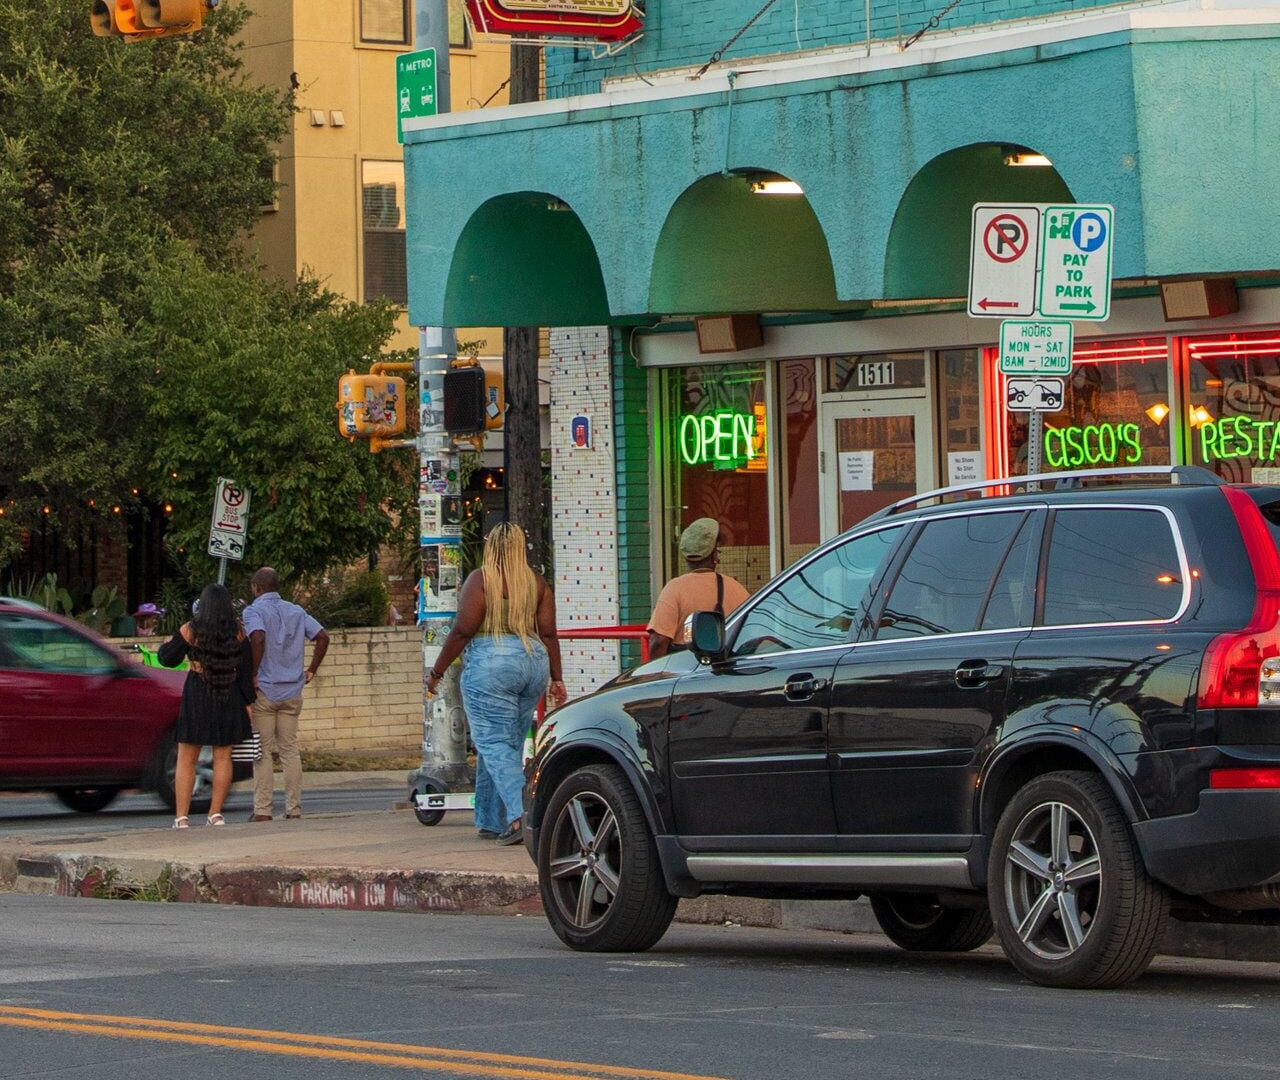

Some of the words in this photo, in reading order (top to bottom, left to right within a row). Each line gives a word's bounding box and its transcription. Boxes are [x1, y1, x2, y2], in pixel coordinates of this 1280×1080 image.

[405, 57, 432, 72] METRO
[1063, 254, 1089, 267] PAY
[1066, 270, 1083, 282] TO
[1055, 285, 1093, 298] PARK
[1021, 326, 1053, 338] HOURS
[1008, 343, 1030, 352] MON
[1046, 342, 1064, 353] SAT
[1004, 356, 1024, 367] 8AM
[1040, 356, 1067, 368] 12MID
[860, 363, 893, 385] 1511
[680, 413, 755, 465] OPEN
[1044, 422, 1142, 468] CISCO'S
[224, 506, 238, 515] BUS
[222, 514, 239, 523] STOP
[299, 880, 348, 906] PARKING
[363, 882, 386, 906] TOW
